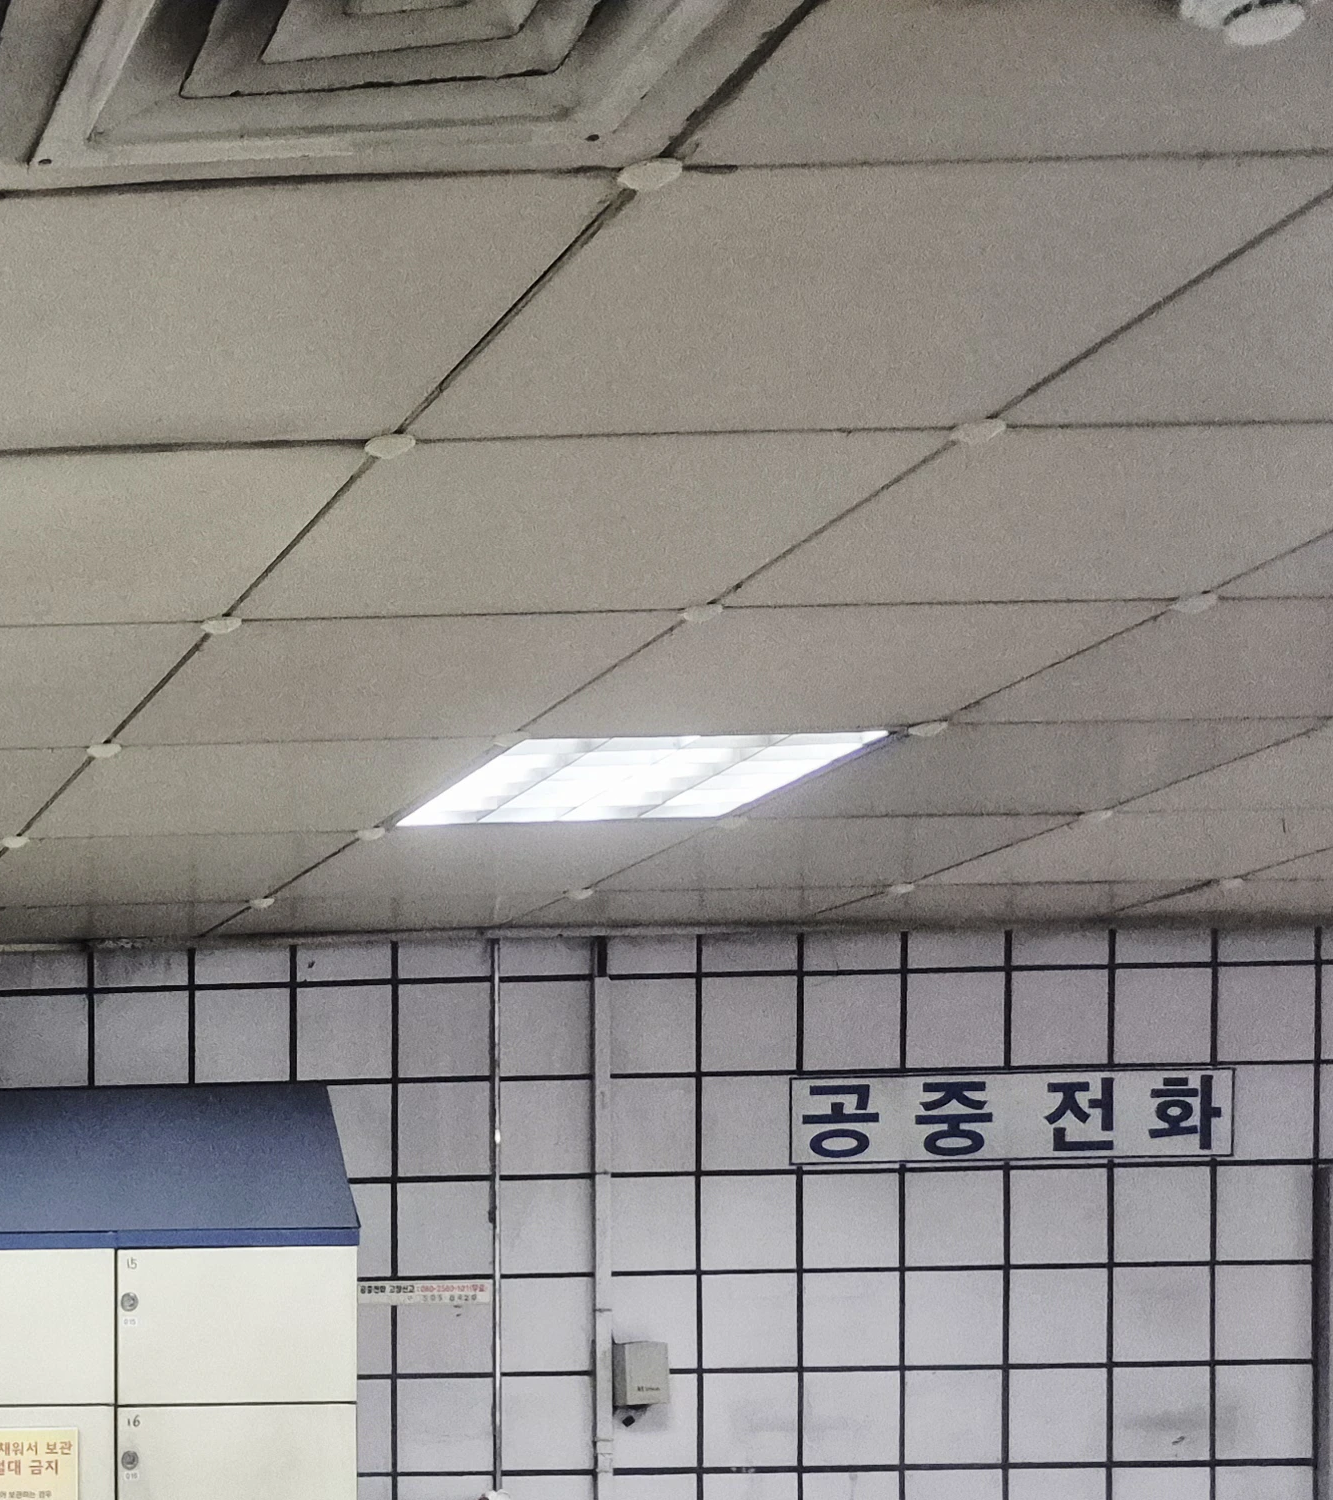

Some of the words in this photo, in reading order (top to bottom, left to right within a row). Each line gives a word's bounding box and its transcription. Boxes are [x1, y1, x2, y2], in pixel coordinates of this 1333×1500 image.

[802, 1074, 1224, 1157] 공중전화
[127, 1415, 140, 1428] 16
[44, 1441, 73, 1456] 보관
[28, 1460, 59, 1475] 금지
